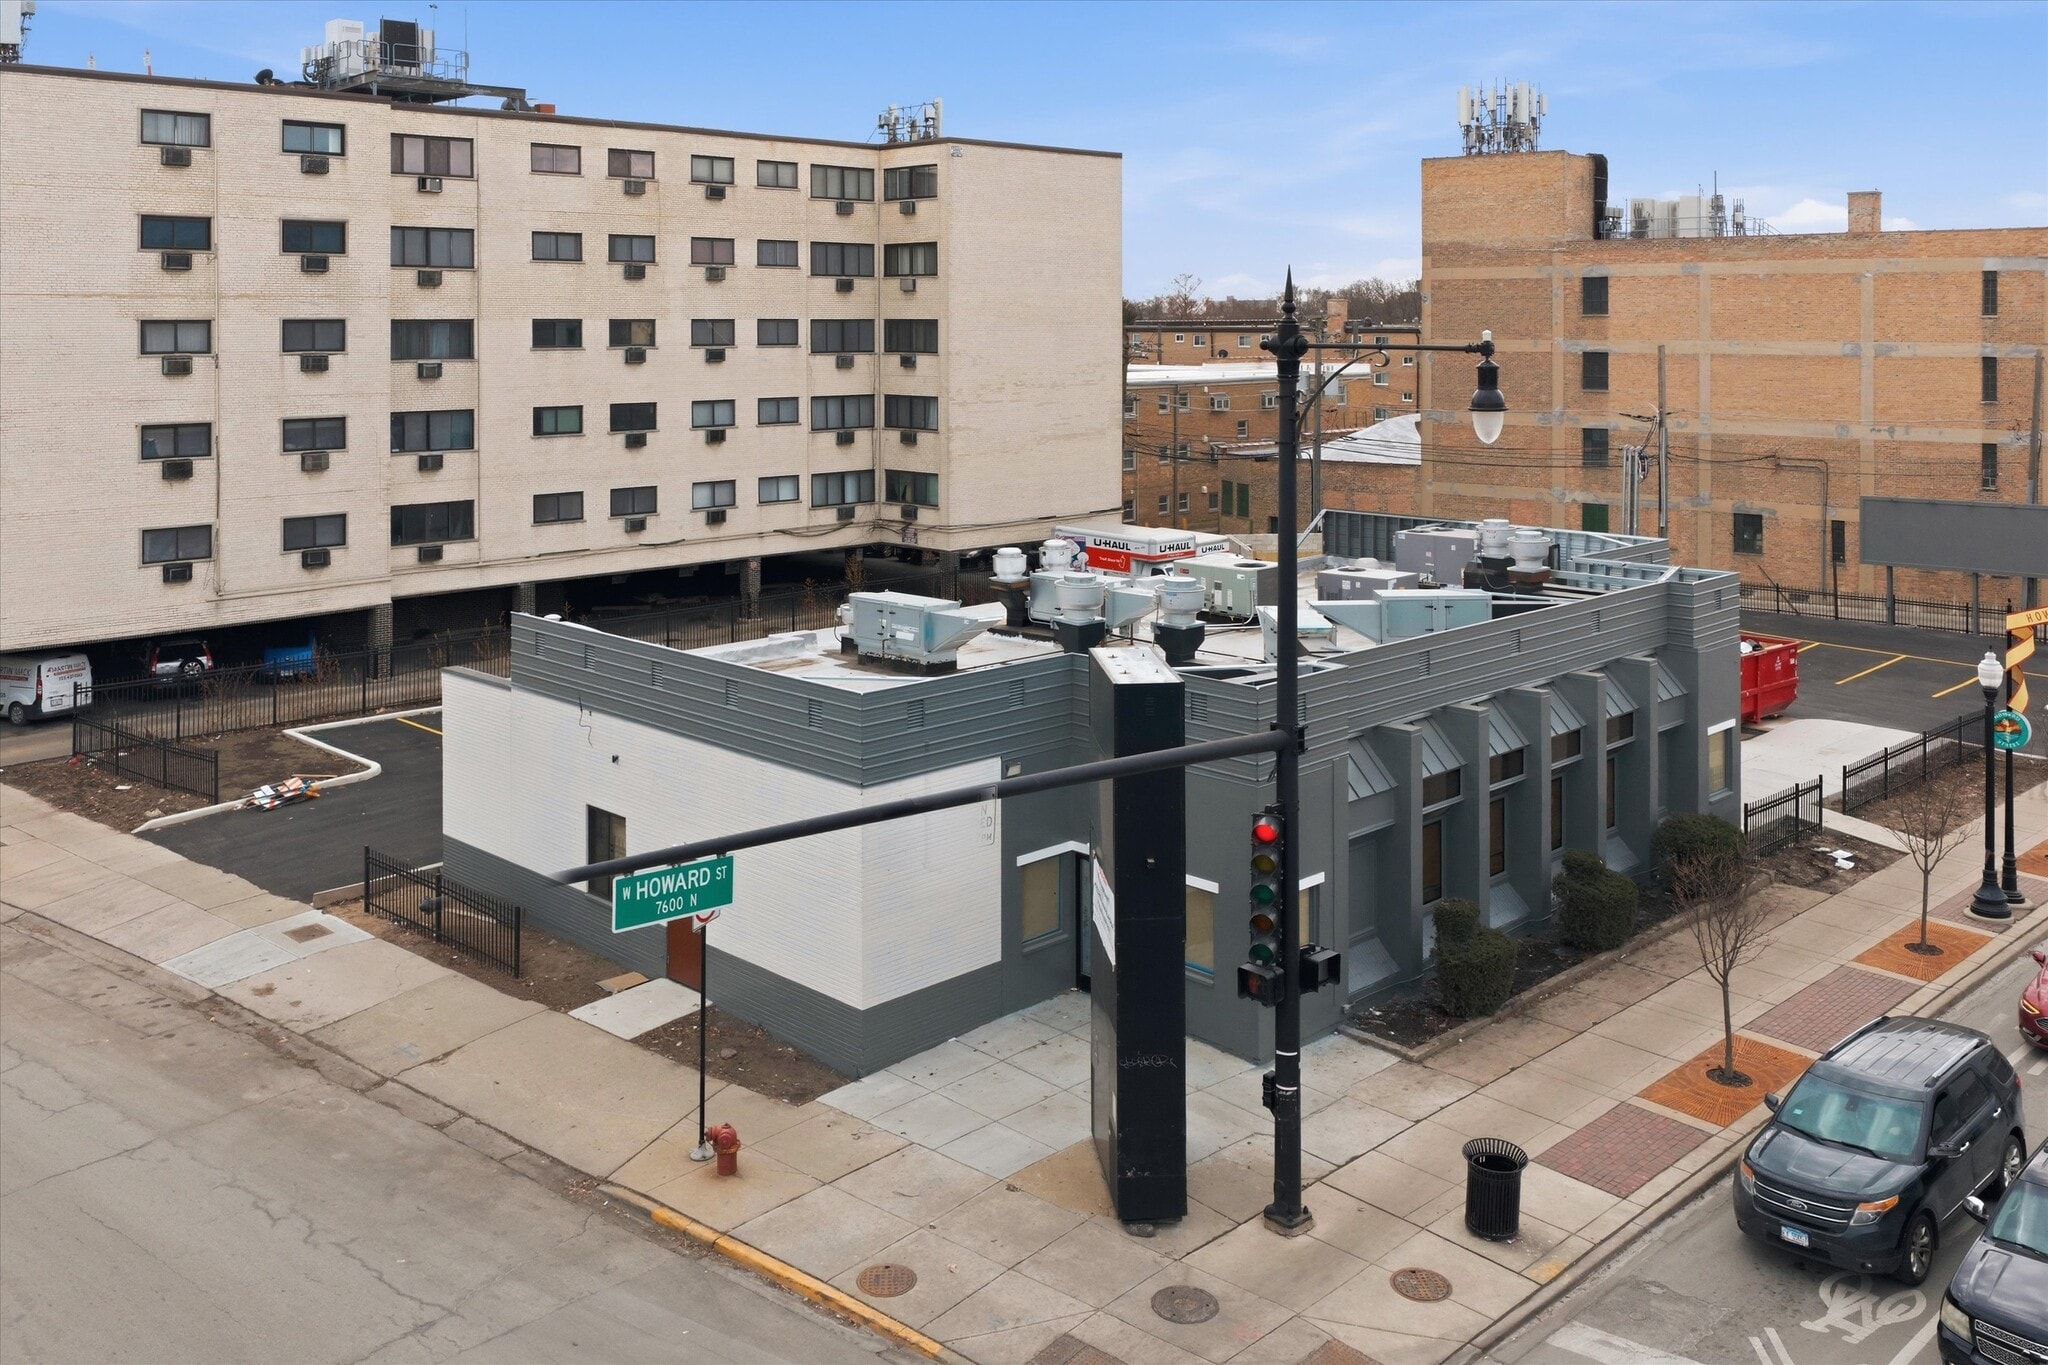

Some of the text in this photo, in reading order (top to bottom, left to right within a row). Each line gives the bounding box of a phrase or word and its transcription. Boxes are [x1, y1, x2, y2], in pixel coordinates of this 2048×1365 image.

[1093, 538, 1131, 551] U-HAUL
[1159, 541, 1191, 553] U-HAUL
[1201, 543, 1225, 553] U-HAUL
[622, 865, 728, 900] W HOWARD ST
[655, 893, 698, 914] 7600 N
